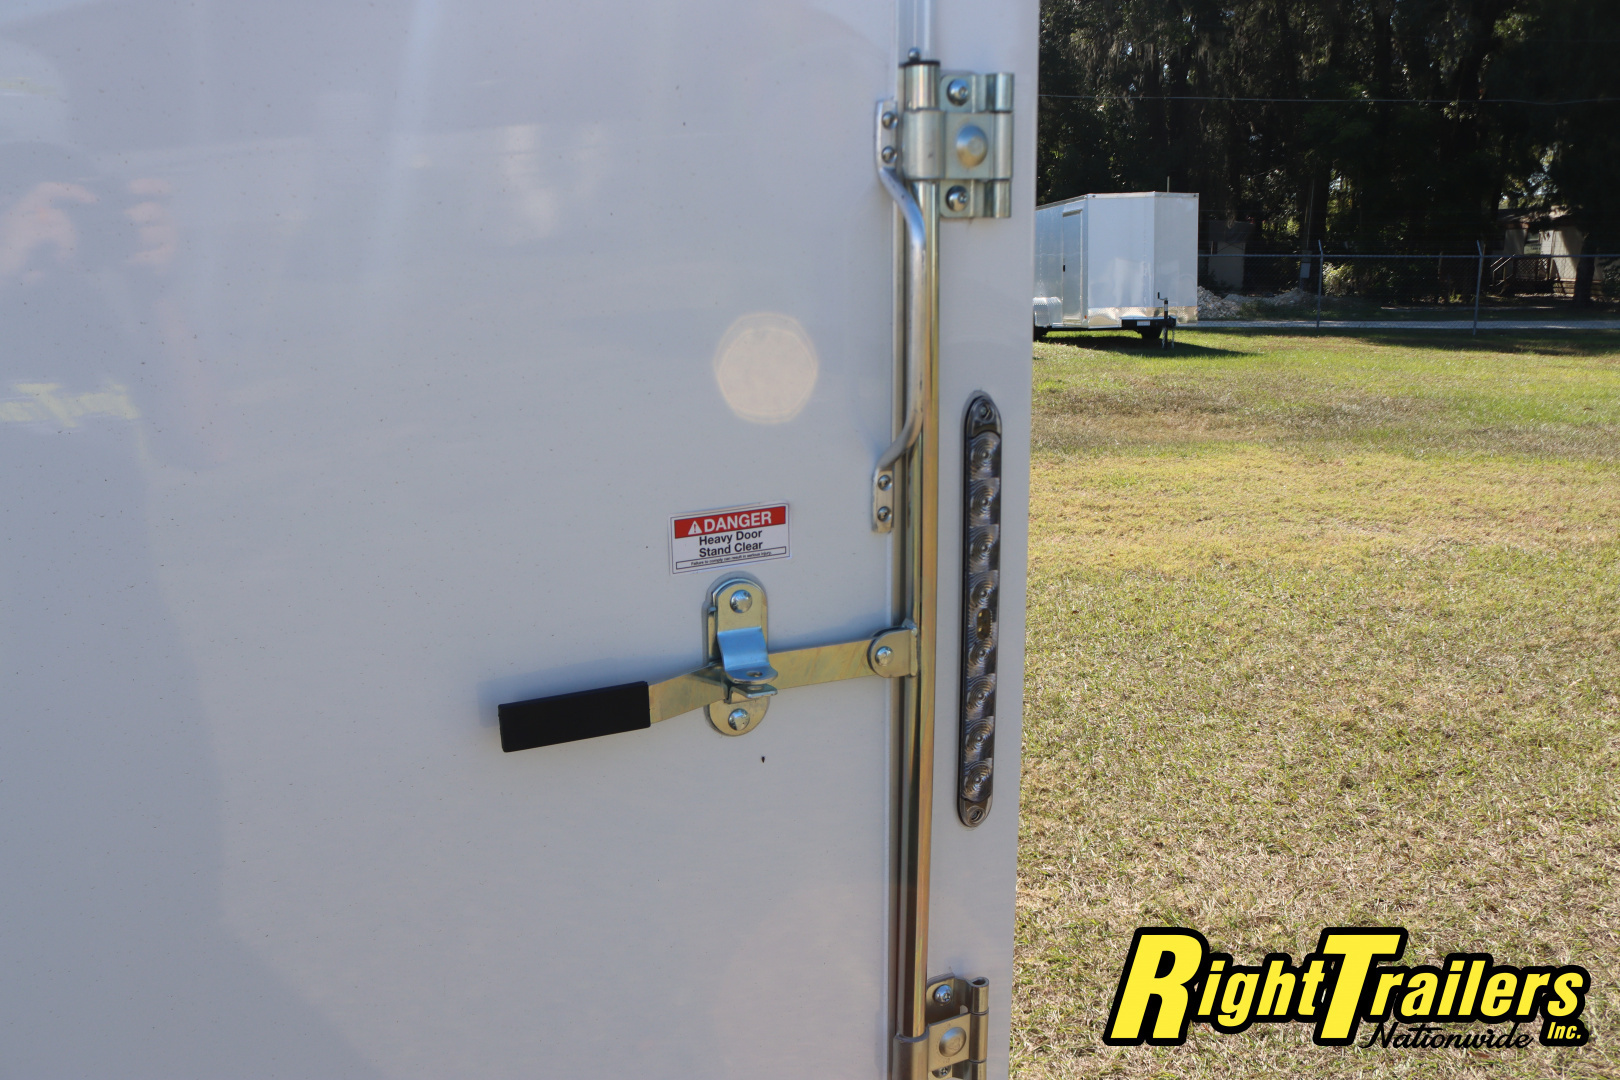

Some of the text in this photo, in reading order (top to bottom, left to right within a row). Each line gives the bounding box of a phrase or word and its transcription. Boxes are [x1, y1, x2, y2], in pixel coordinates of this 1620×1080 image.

[704, 511, 772, 533] DANGER
[699, 530, 763, 546] Heavy Door
[699, 542, 763, 558] Stand Clear
